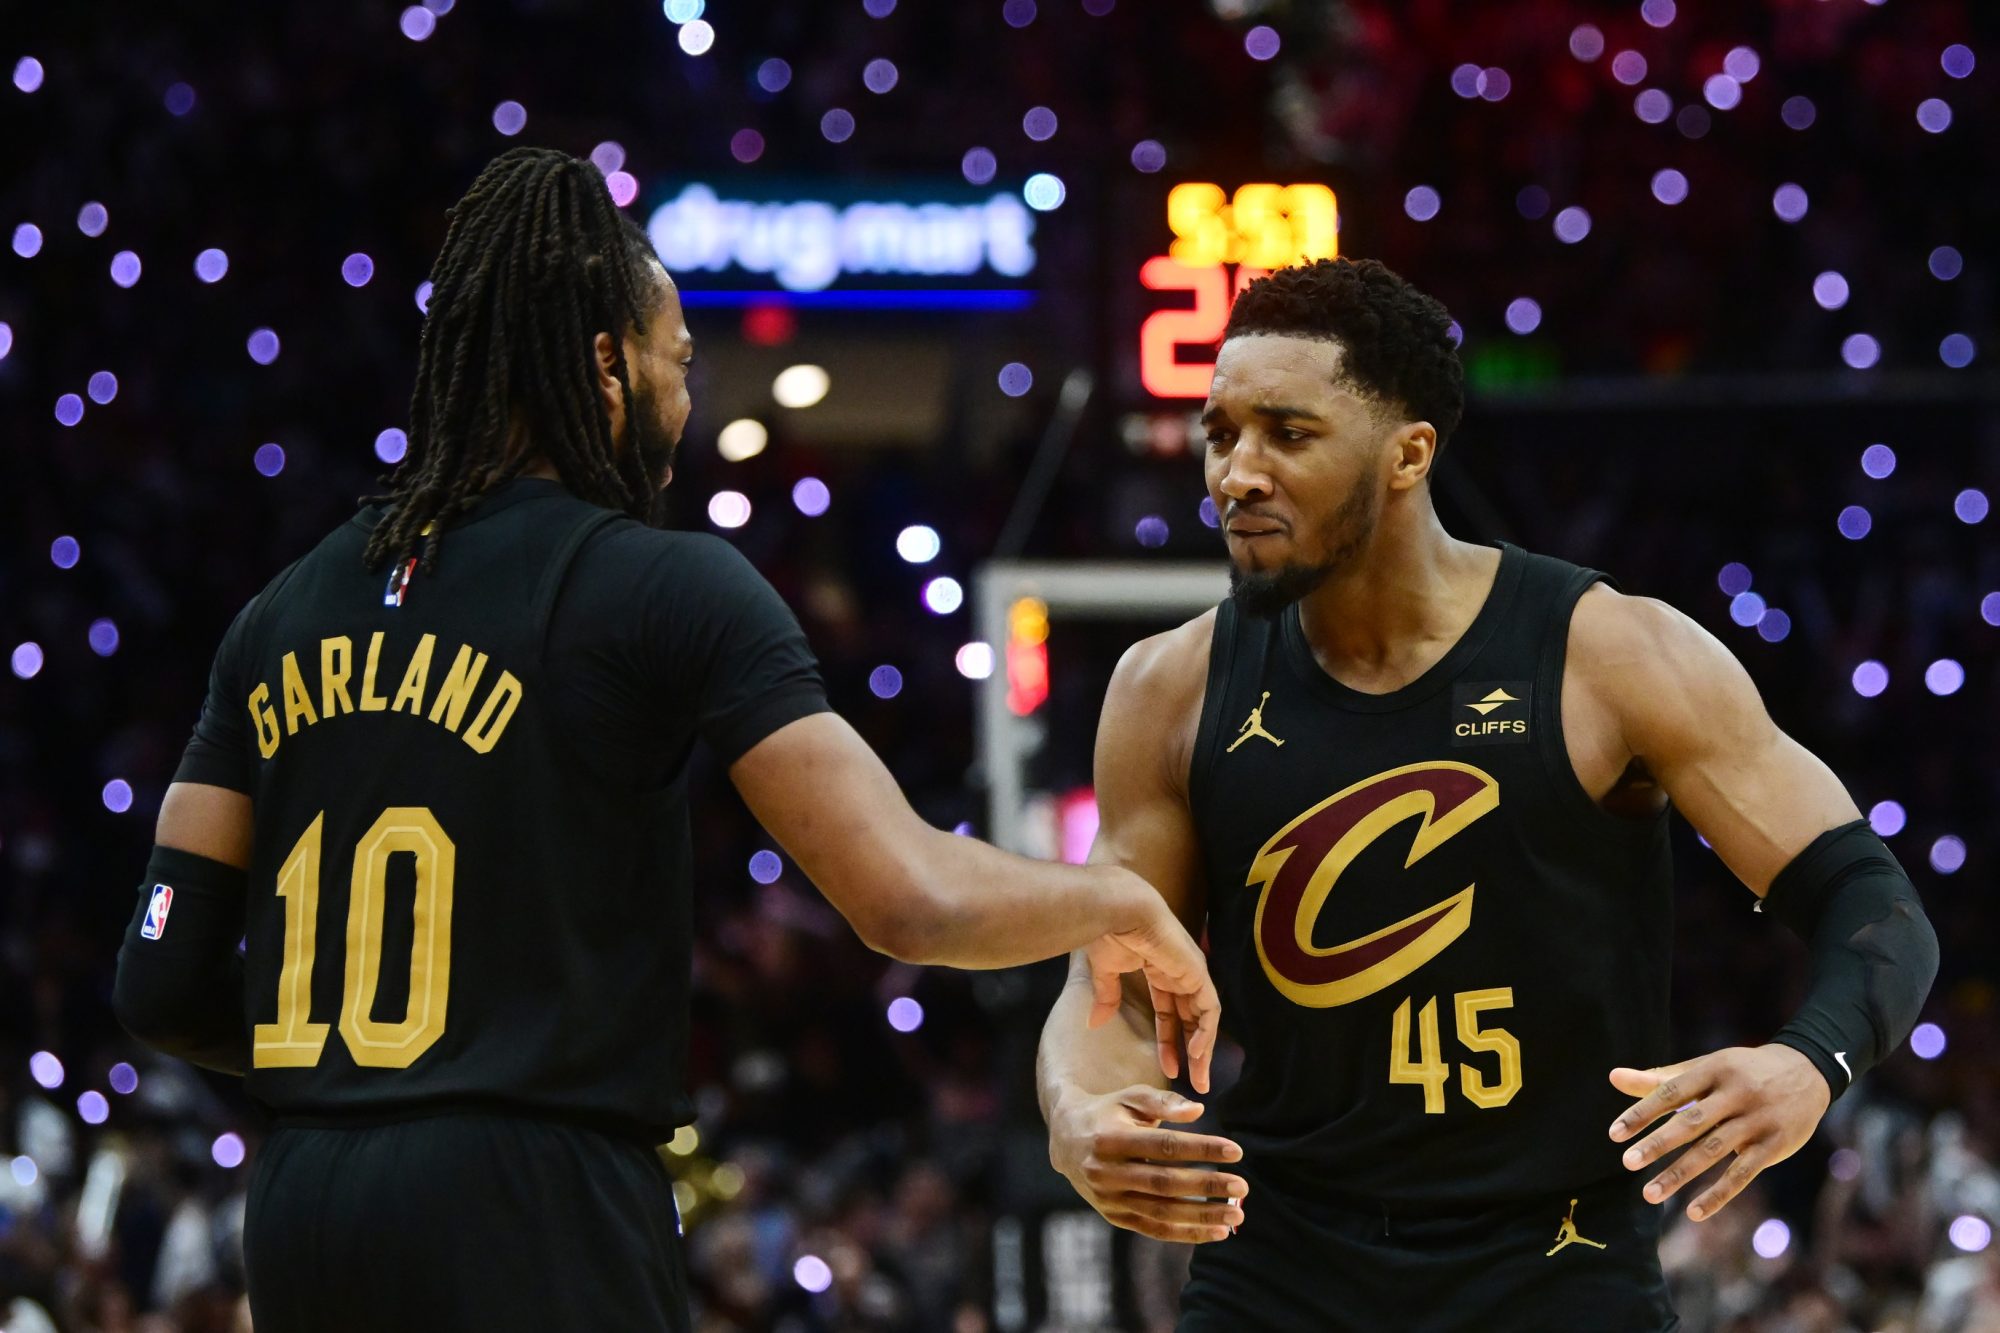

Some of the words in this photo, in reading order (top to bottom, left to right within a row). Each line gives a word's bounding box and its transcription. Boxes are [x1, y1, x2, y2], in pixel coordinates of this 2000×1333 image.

[248, 632, 522, 759] GARLAND
[1455, 720, 1526, 736] CLIFFS
[253, 807, 456, 1069] 10
[1389, 987, 1522, 1114] 45
